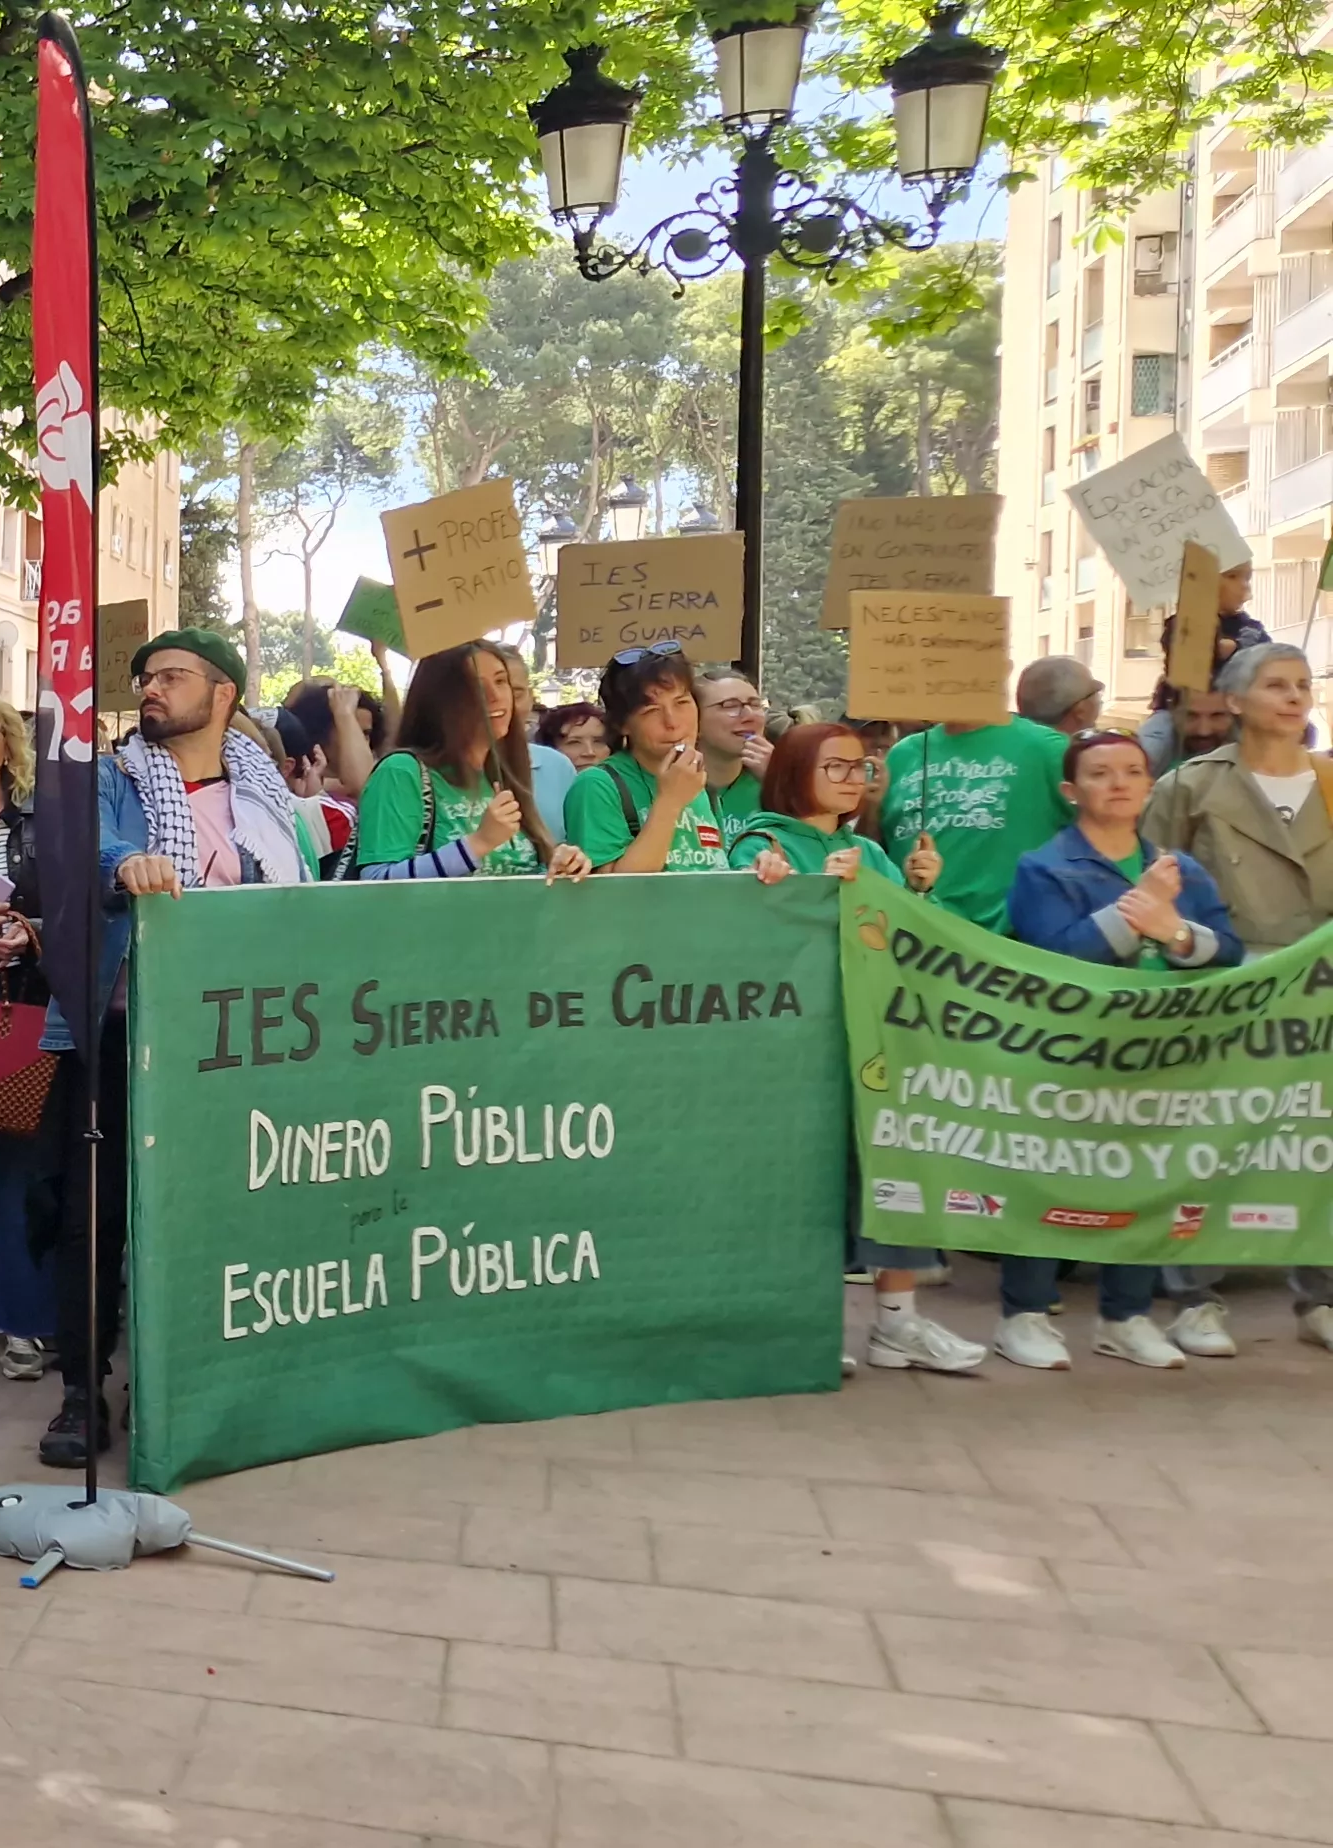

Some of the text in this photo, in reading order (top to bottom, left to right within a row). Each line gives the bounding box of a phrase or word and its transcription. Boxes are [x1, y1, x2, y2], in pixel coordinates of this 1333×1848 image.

[437, 505, 523, 557] PROFES
[447, 557, 523, 604] RATIO
[579, 561, 649, 587] IES
[609, 584, 720, 613] SIERRA
[579, 620, 707, 644] DE GUARA
[890, 926, 1094, 1016] DINERO
[197, 963, 803, 1073] IES SIERRA DE GUARA
[940, 999, 1210, 1072] EDUCACIÓN
[979, 1074, 1022, 1115] AL
[1026, 1082, 1276, 1128] CONCIERTO
[1273, 1080, 1332, 1119] DEL
[247, 1084, 616, 1192] DINERO PÚBLICO
[1138, 1142, 1175, 1180] Y
[222, 1220, 601, 1341] ESCUELA PÚBLICA
